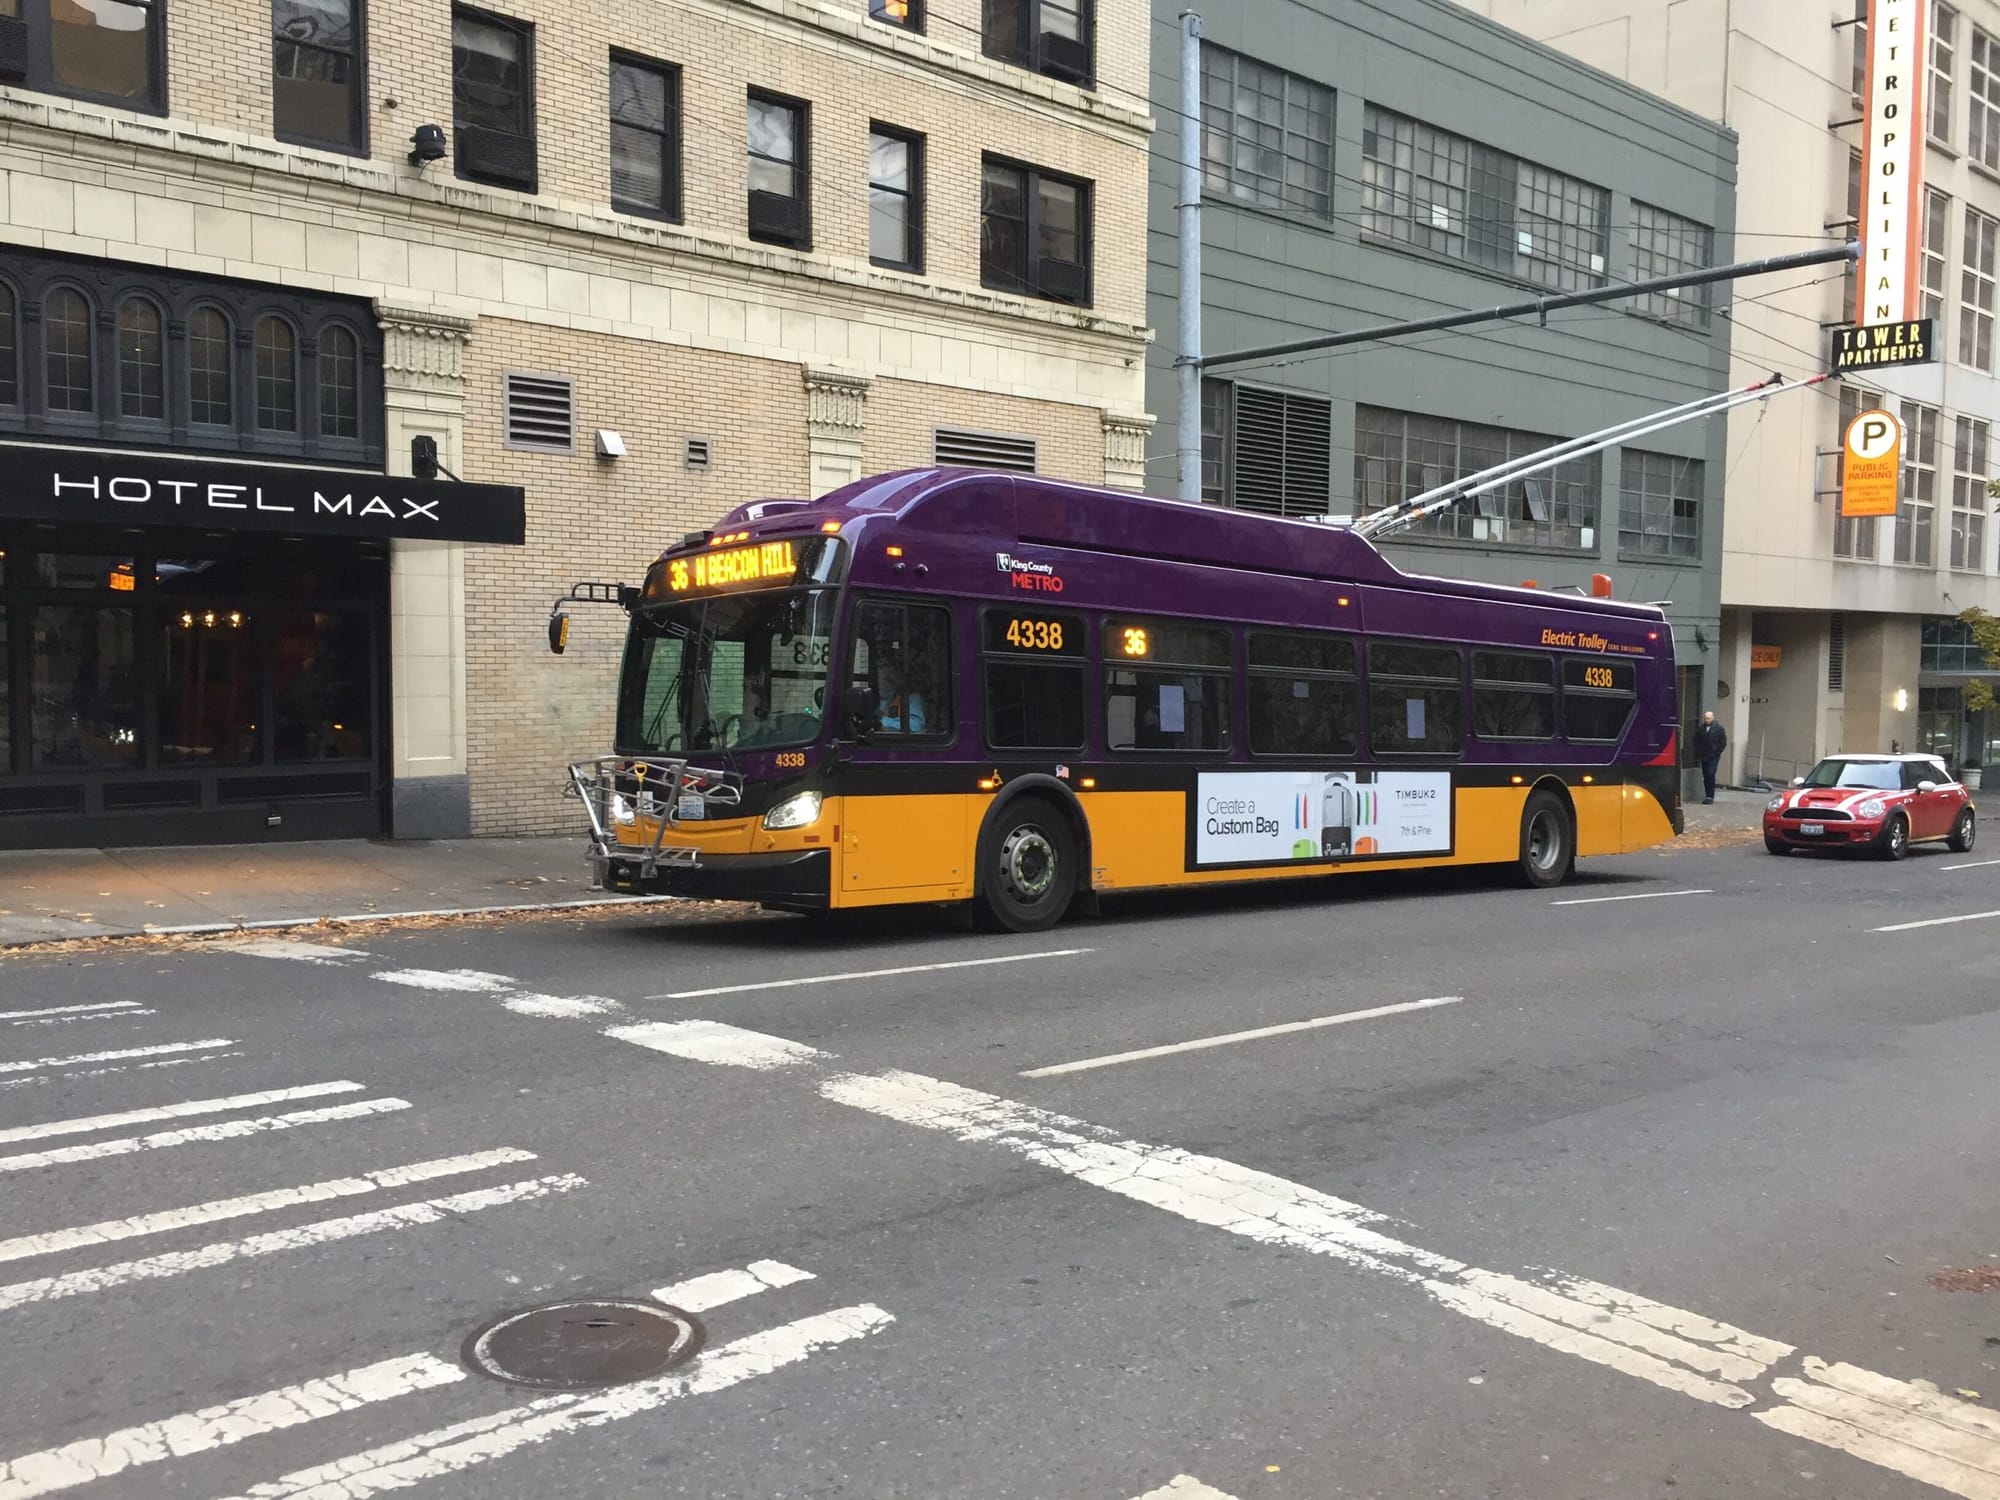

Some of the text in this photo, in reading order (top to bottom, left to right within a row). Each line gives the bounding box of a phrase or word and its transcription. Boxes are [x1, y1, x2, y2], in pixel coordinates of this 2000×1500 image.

[1843, 323, 1920, 350] TOWER
[1838, 343, 1924, 367] APARTMENTS
[1862, 421, 1887, 451] P
[1848, 470, 1893, 481] PARKING
[1852, 462, 1889, 472] PUBLIC
[53, 472, 440, 521] HOTEL MAX
[670, 559, 689, 591] 36
[708, 547, 760, 586] BEACON
[761, 541, 797, 577] HILL
[1011, 559, 1053, 575] King County
[1012, 572, 1064, 593] METRO
[1006, 618, 1064, 650] 4338
[1123, 627, 1147, 656] 36
[1541, 628, 1576, 647] Electric
[1578, 632, 1609, 653] Trolley
[1584, 666, 1613, 688] 4338
[775, 752, 806, 768] 4338
[1206, 796, 1256, 815] Create a
[1395, 789, 1436, 800] TIMBUK2
[1206, 816, 1279, 837] Custom Bag
